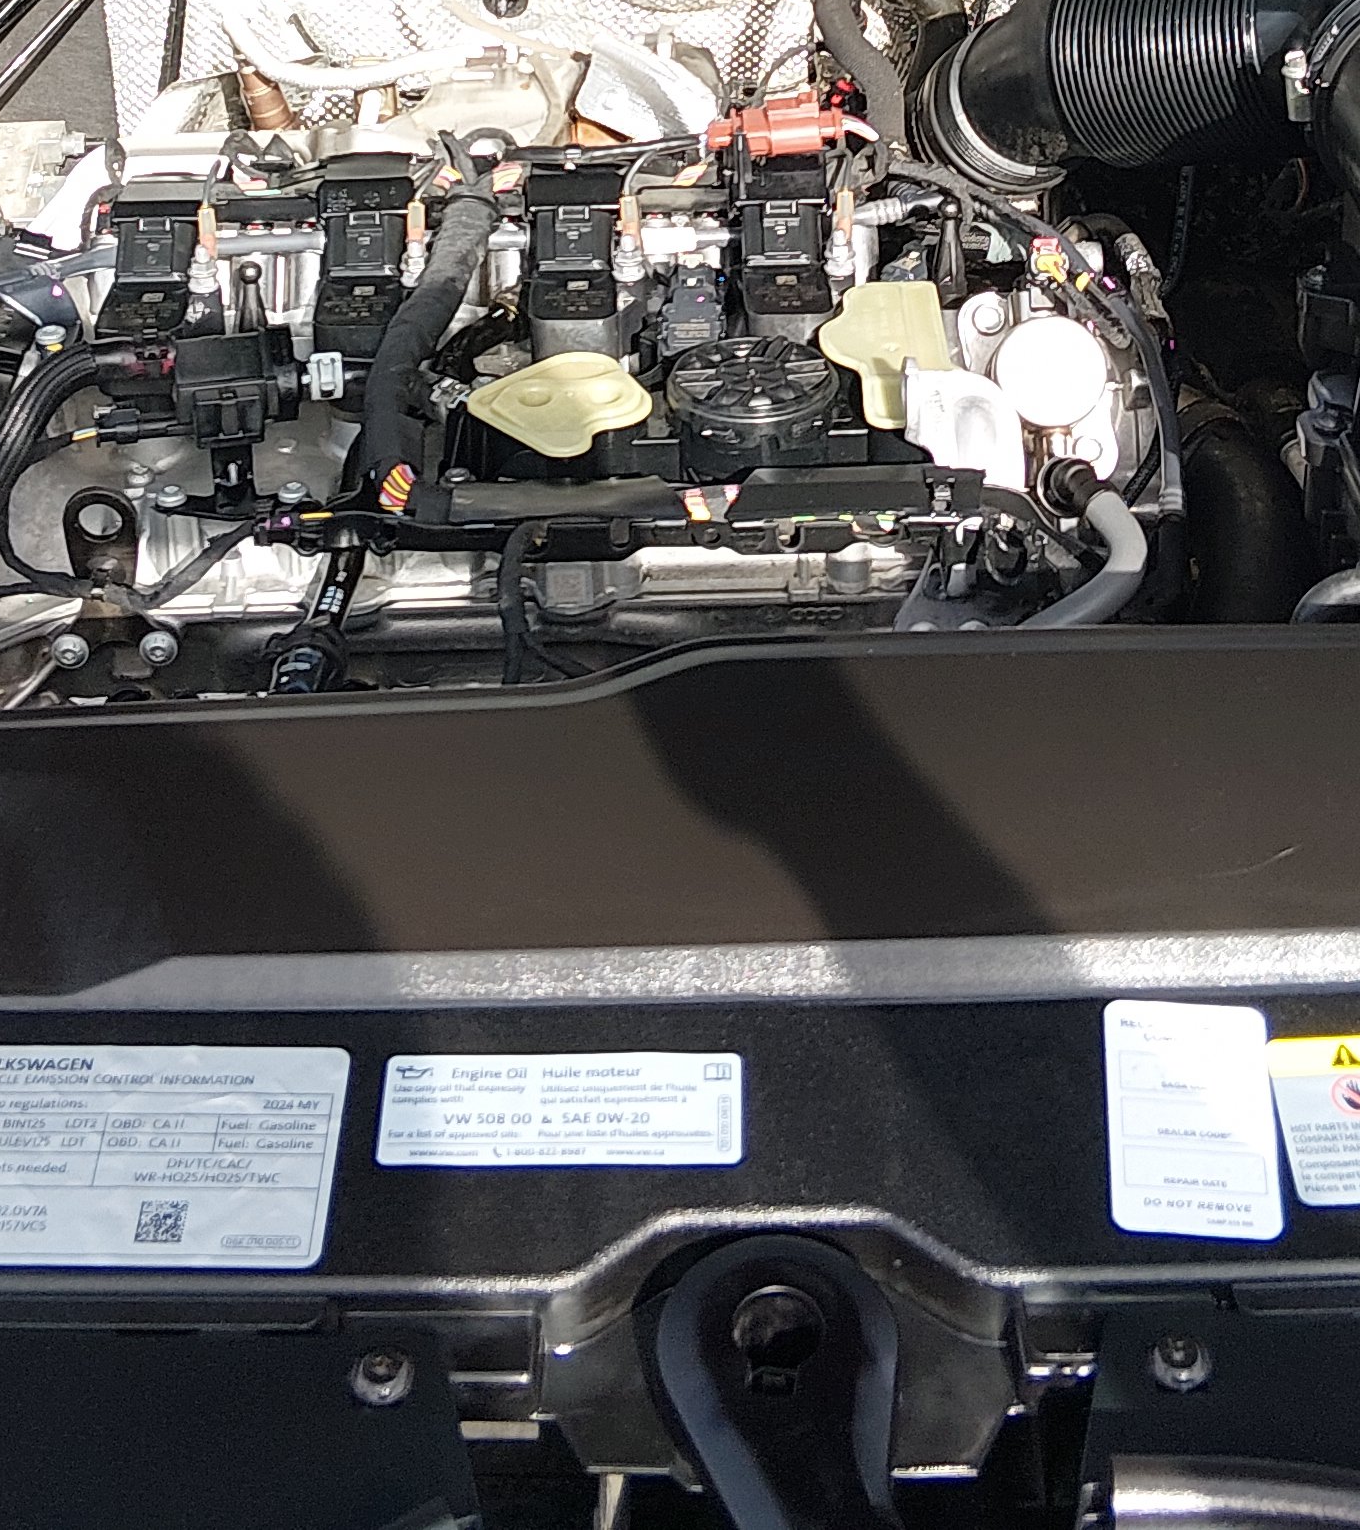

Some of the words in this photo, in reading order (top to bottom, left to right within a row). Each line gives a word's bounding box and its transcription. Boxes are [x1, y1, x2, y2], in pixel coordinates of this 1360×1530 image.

[452, 1067, 502, 1082] Engine
[507, 1067, 528, 1078] Oil
[542, 1067, 581, 1078] Huile
[586, 1067, 642, 1078] moteur
[24, 1075, 89, 1084] EMISSION
[93, 1075, 154, 1085] CONTROL
[160, 1075, 255, 1085] INFORMATION
[263, 1100, 294, 1109] 2024
[443, 1113, 472, 1124] VW
[477, 1113, 506, 1124] 508
[510, 1113, 532, 1124] 00
[541, 1115, 552, 1124] &
[562, 1112, 592, 1124] SAE
[596, 1112, 650, 1124] 0W-20
[153, 1119, 171, 1129] CA
[259, 1120, 317, 1131] Gasoline
[1290, 1123, 1312, 1133] HOT
[1314, 1121, 1349, 1131] PARTS
[61, 1137, 86, 1147] LDT
[149, 1138, 168, 1148] CA
[218, 1138, 249, 1148] Fuel:
[256, 1138, 314, 1149] Gasoline
[1295, 1144, 1340, 1154] MOVING
[1163, 1176, 1199, 1186] REPAIR
[1301, 1171, 1312, 1180] le
[1143, 1197, 1162, 1207] DO
[1166, 1199, 1193, 1208] NOT
[1197, 1201, 1253, 1212] REMOVE
